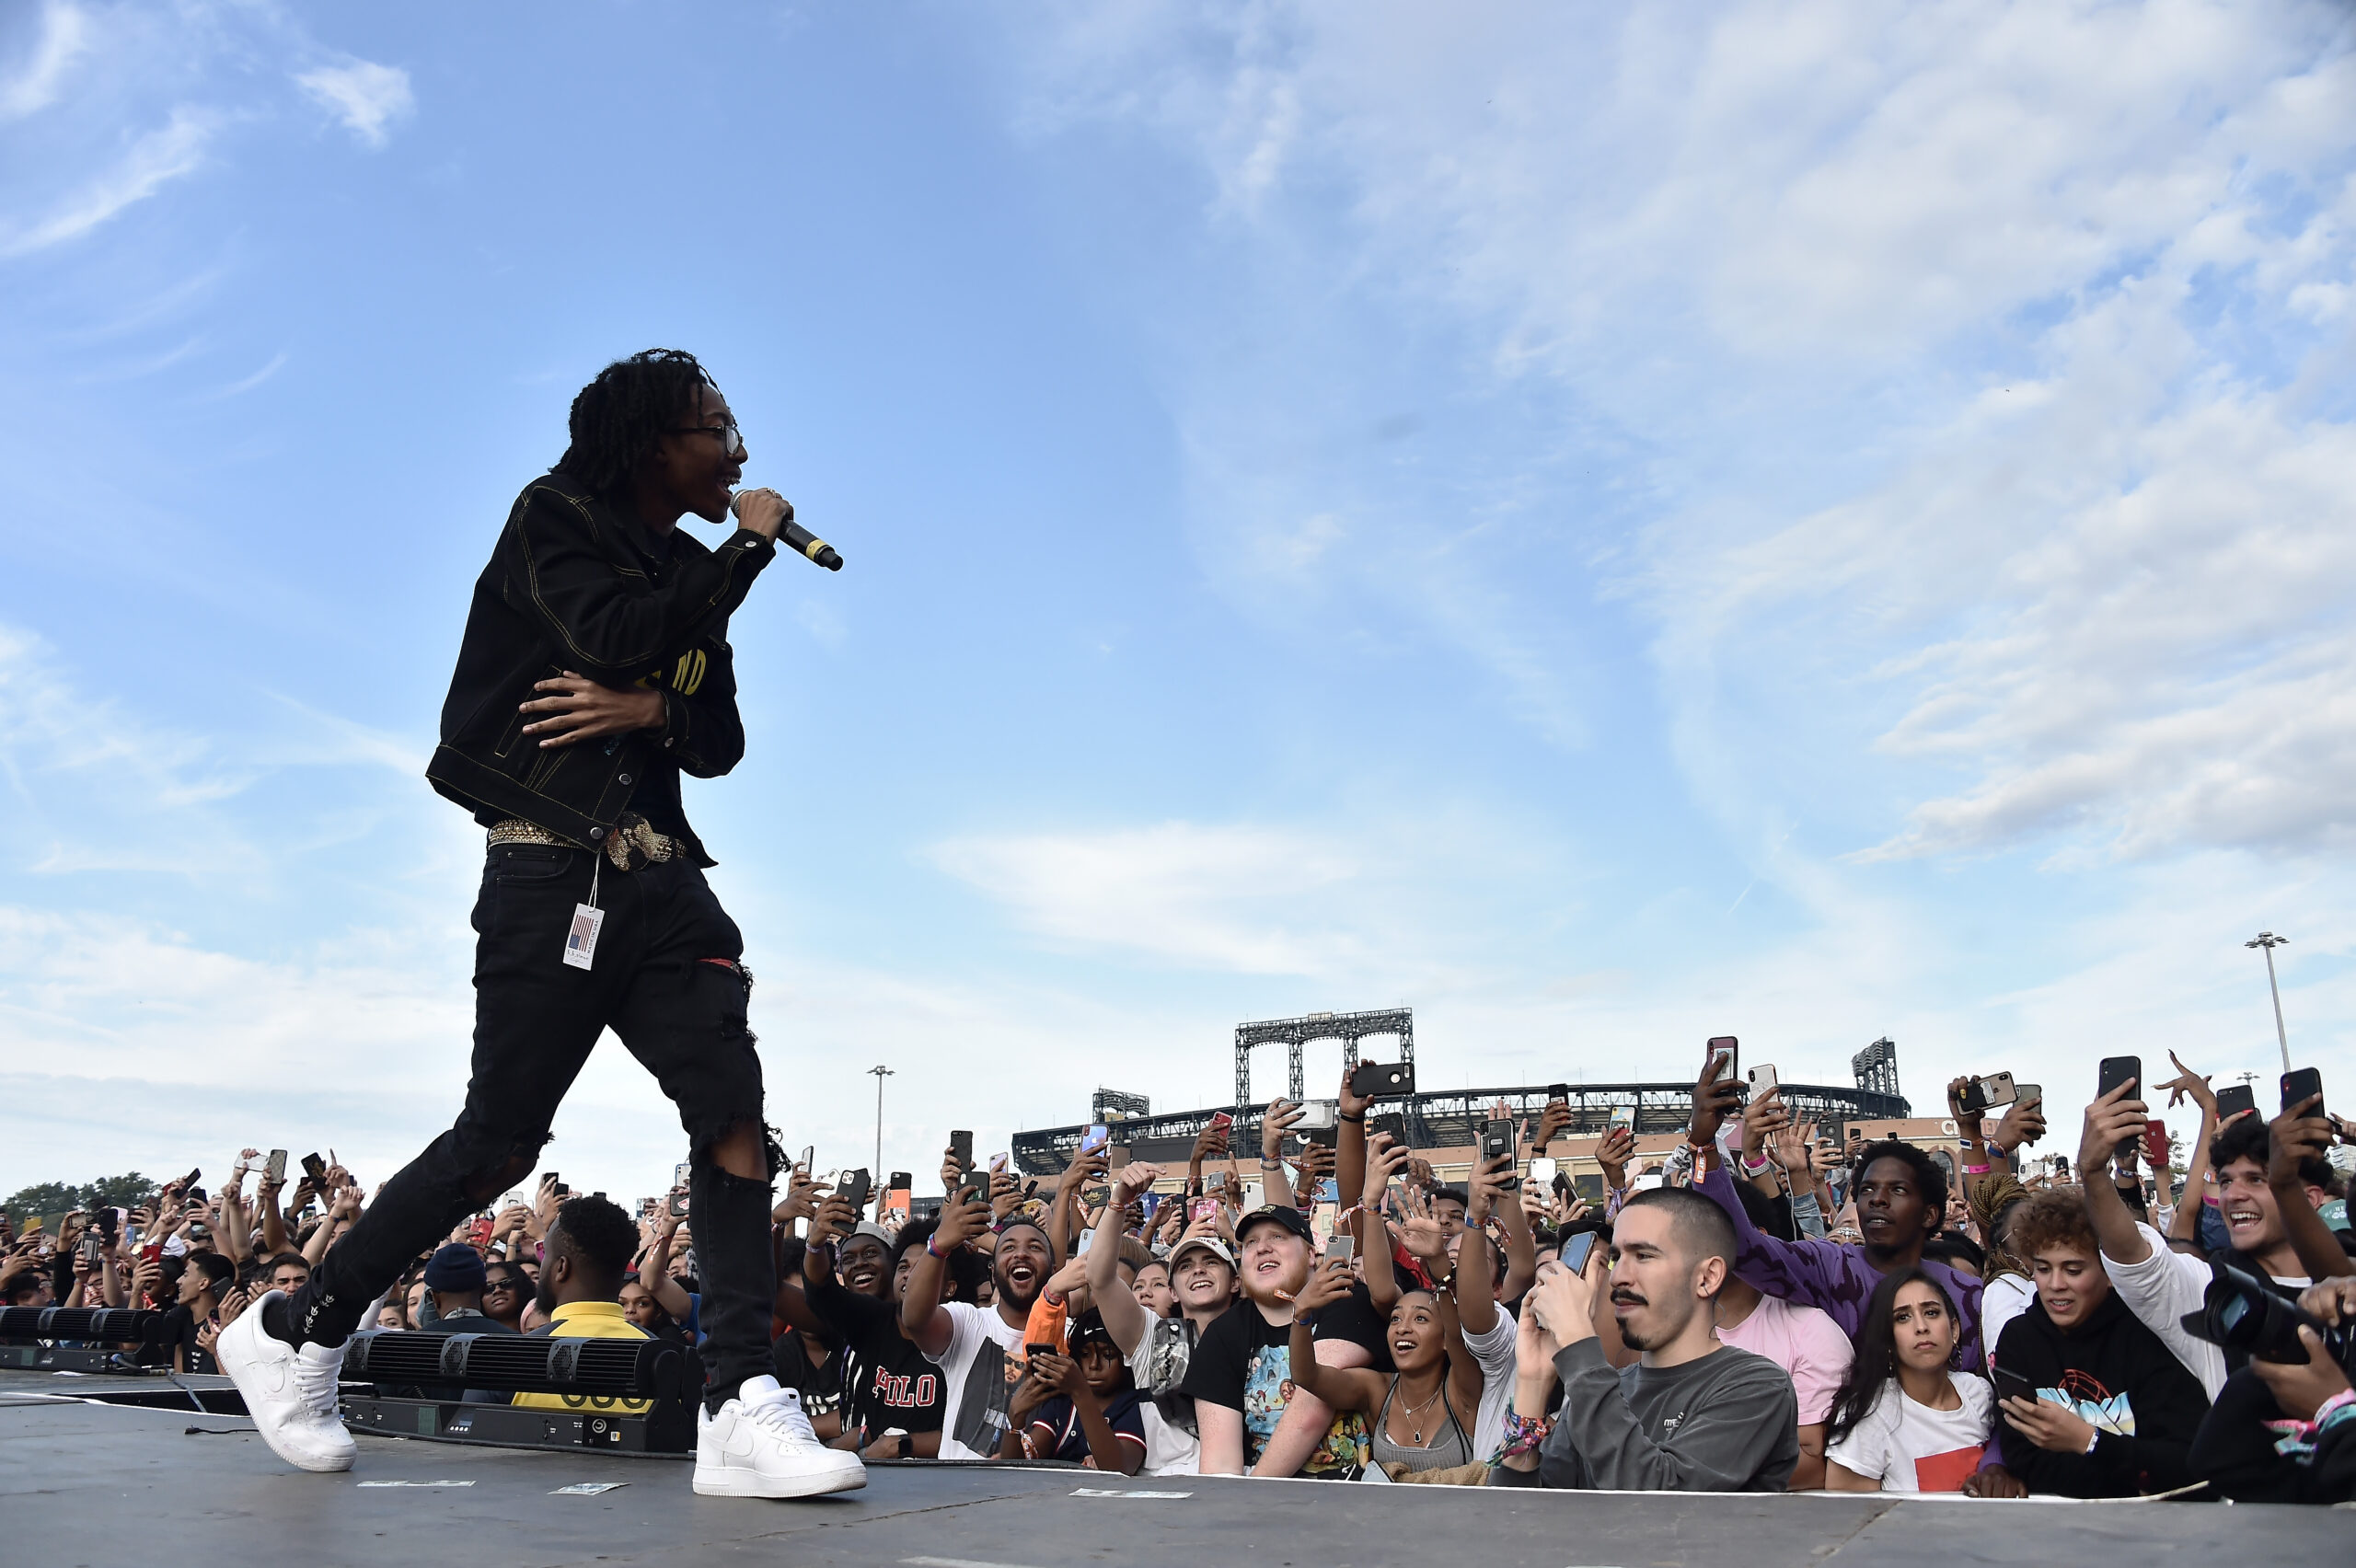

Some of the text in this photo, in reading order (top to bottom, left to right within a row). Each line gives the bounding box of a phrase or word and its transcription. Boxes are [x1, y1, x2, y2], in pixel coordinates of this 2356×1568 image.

[651, 649, 707, 696] ND
[1941, 1119, 1959, 1136] CI
[873, 1366, 936, 1407] POLO
